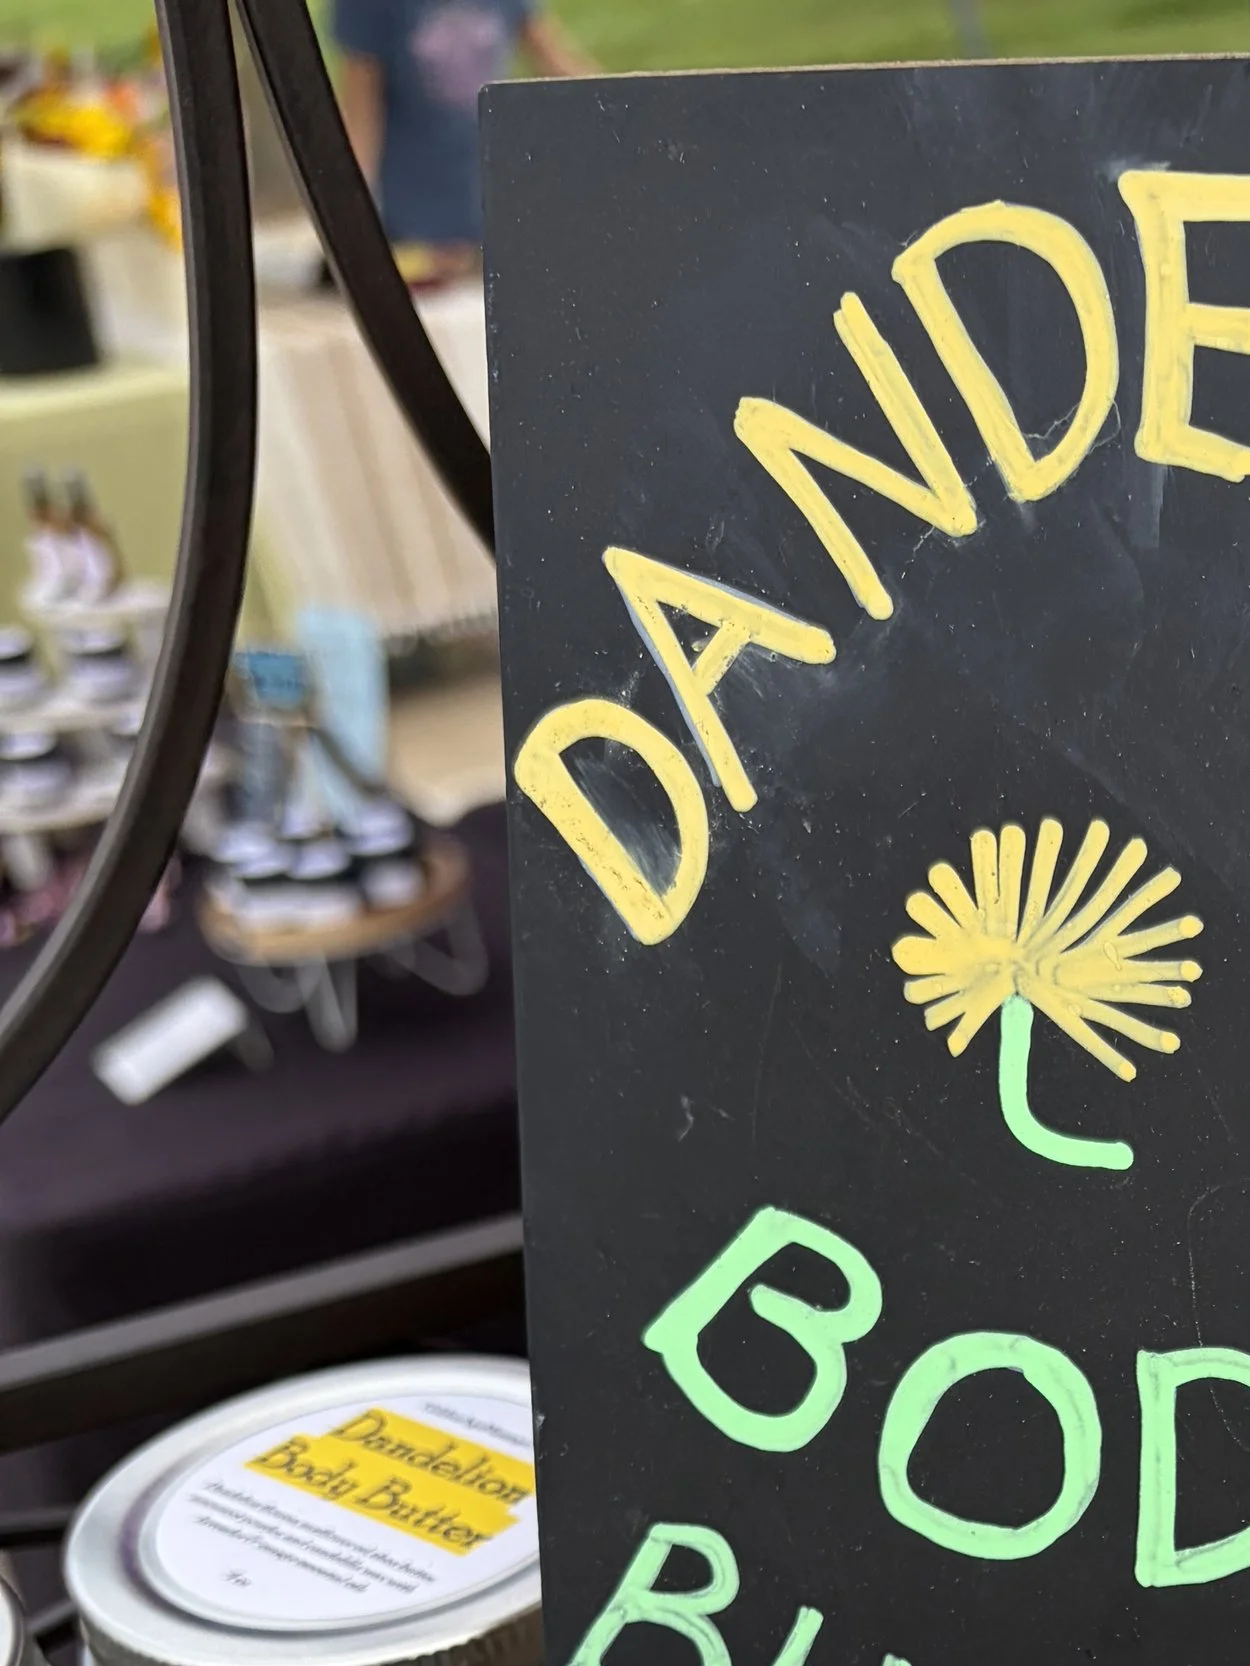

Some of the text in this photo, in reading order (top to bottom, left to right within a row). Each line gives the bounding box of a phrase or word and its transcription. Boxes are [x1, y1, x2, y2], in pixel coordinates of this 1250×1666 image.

[256, 1435, 359, 1501] Body
[354, 1475, 492, 1547] Butter
[330, 1408, 533, 1505] Dandelion
